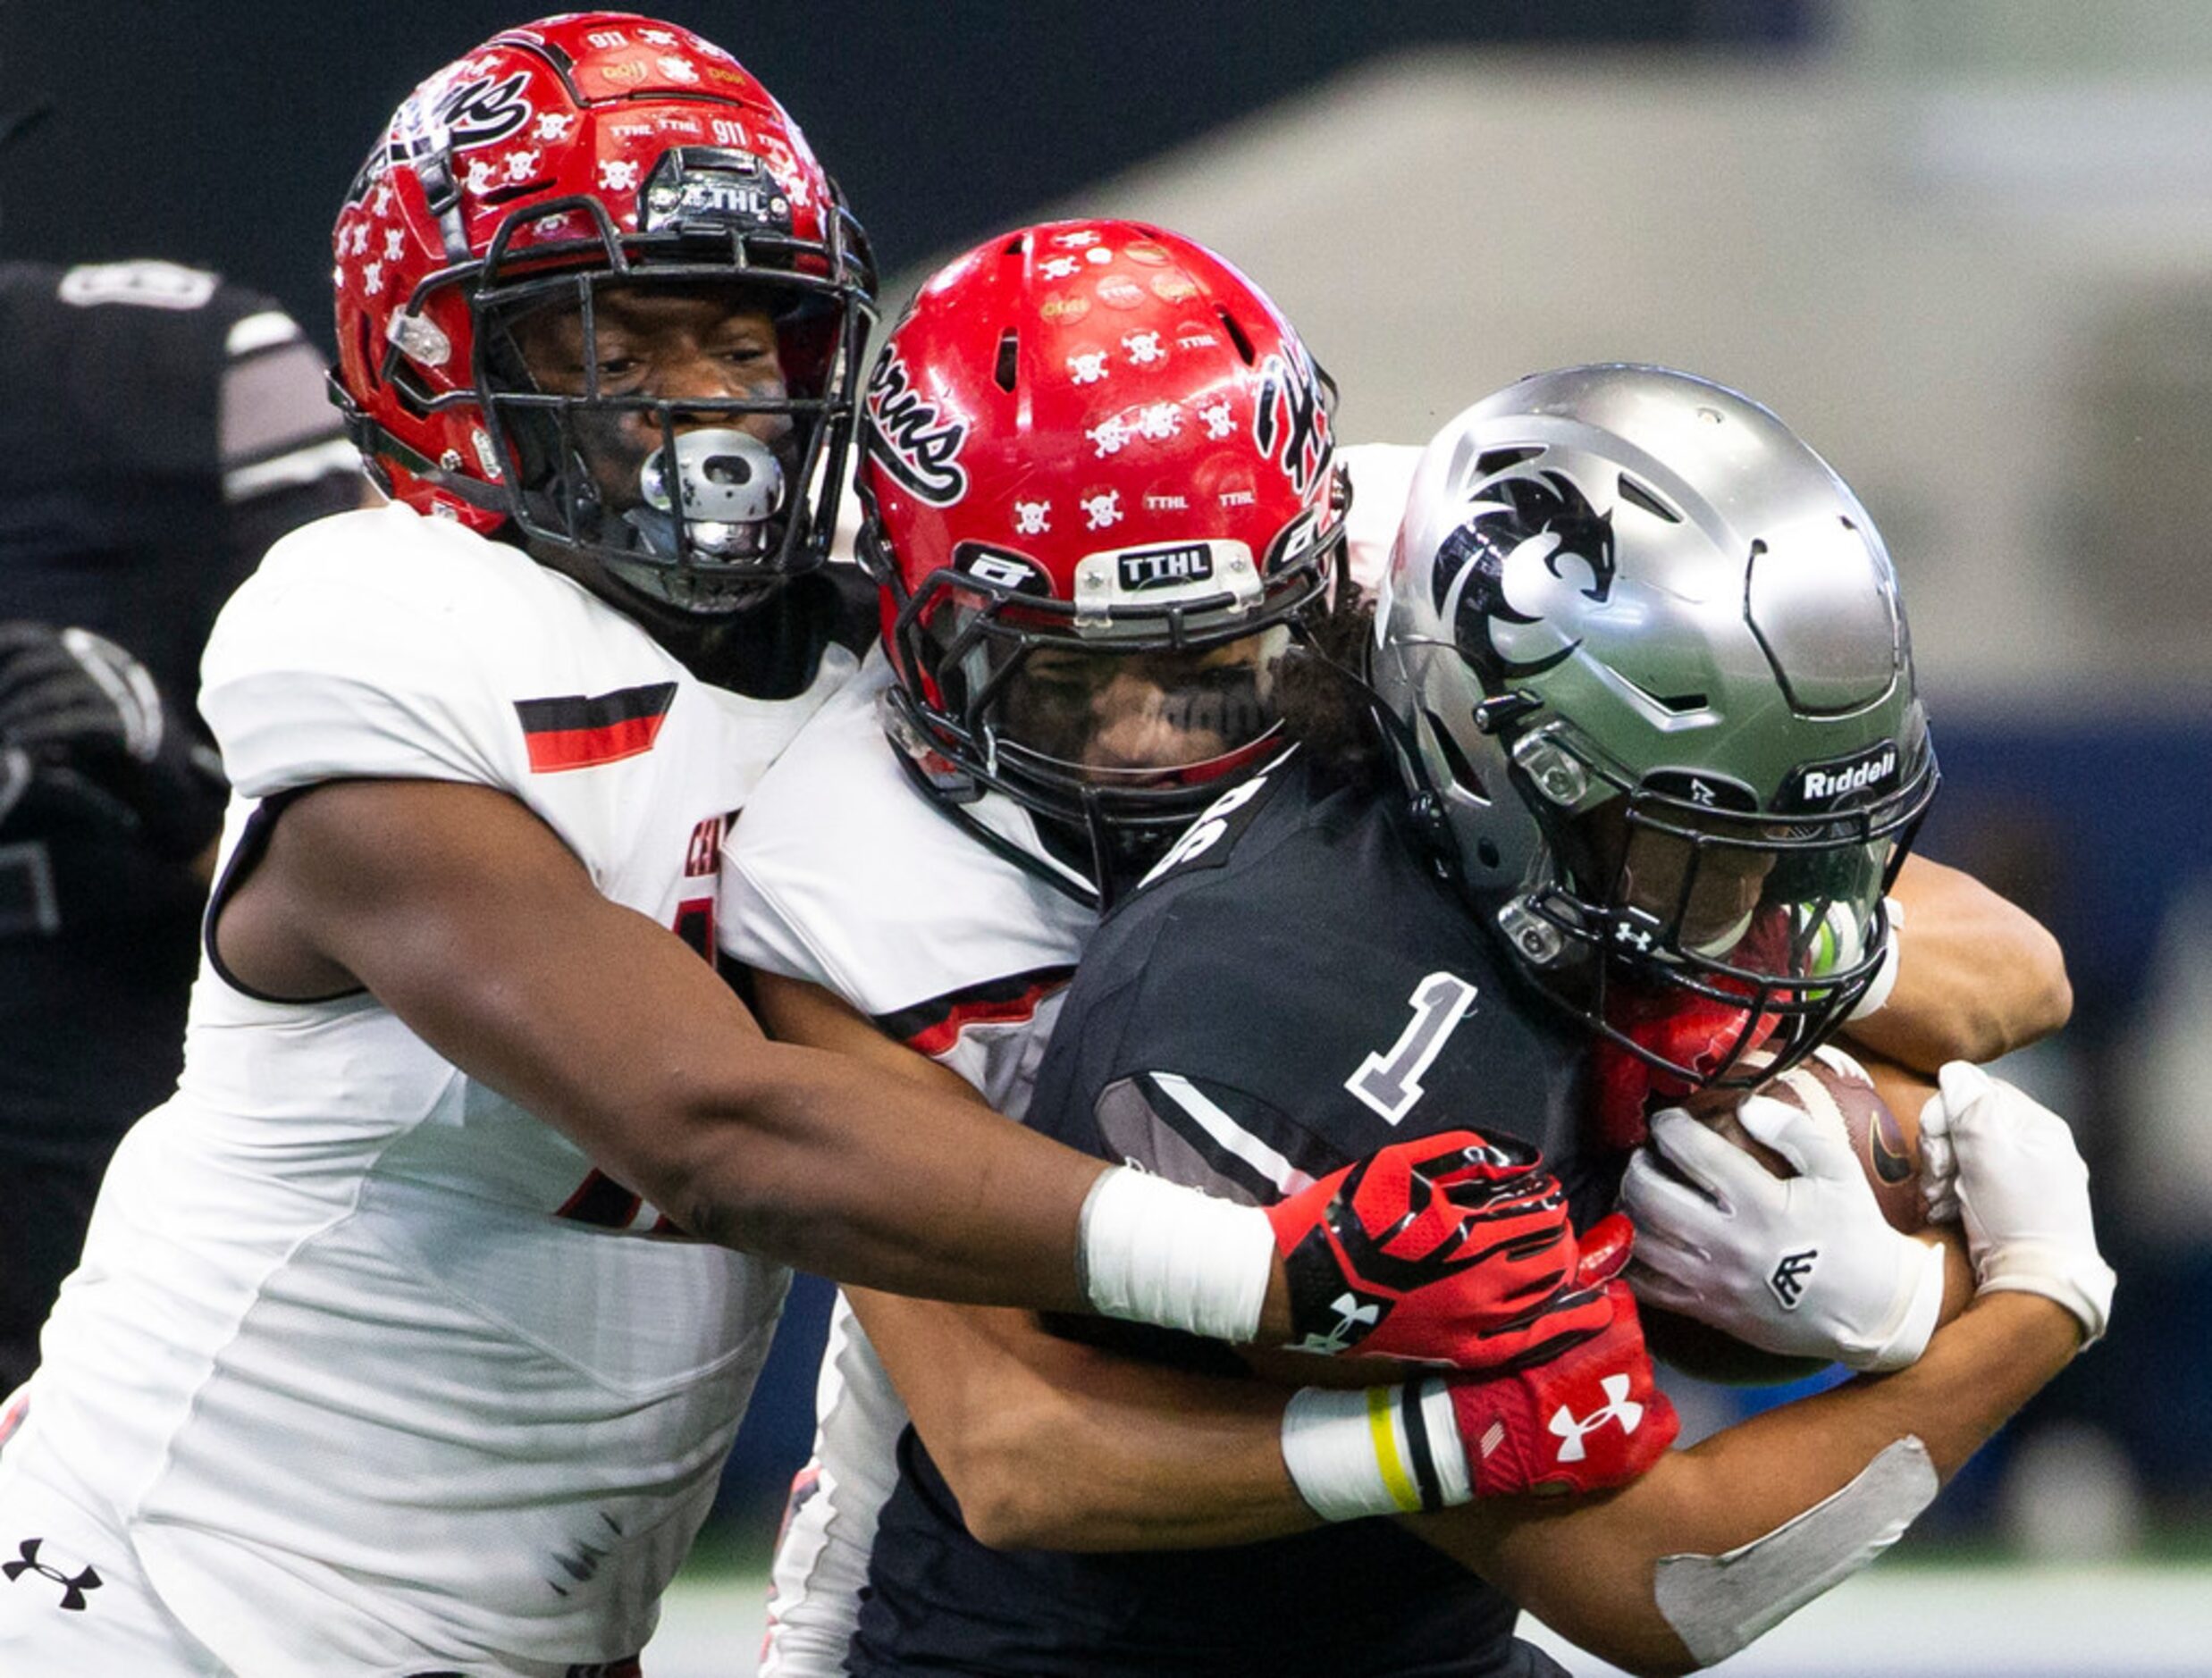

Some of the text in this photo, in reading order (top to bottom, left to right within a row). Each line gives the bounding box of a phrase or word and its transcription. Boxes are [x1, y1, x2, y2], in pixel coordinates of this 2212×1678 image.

[587, 31, 629, 48] 911
[712, 119, 747, 146] 911
[1146, 495, 1190, 510] TTHL
[1218, 491, 1256, 508] TTHL
[1123, 550, 1209, 582] TTHL
[1803, 751, 1896, 801] Riddell
[1343, 970, 1479, 1128] 1
